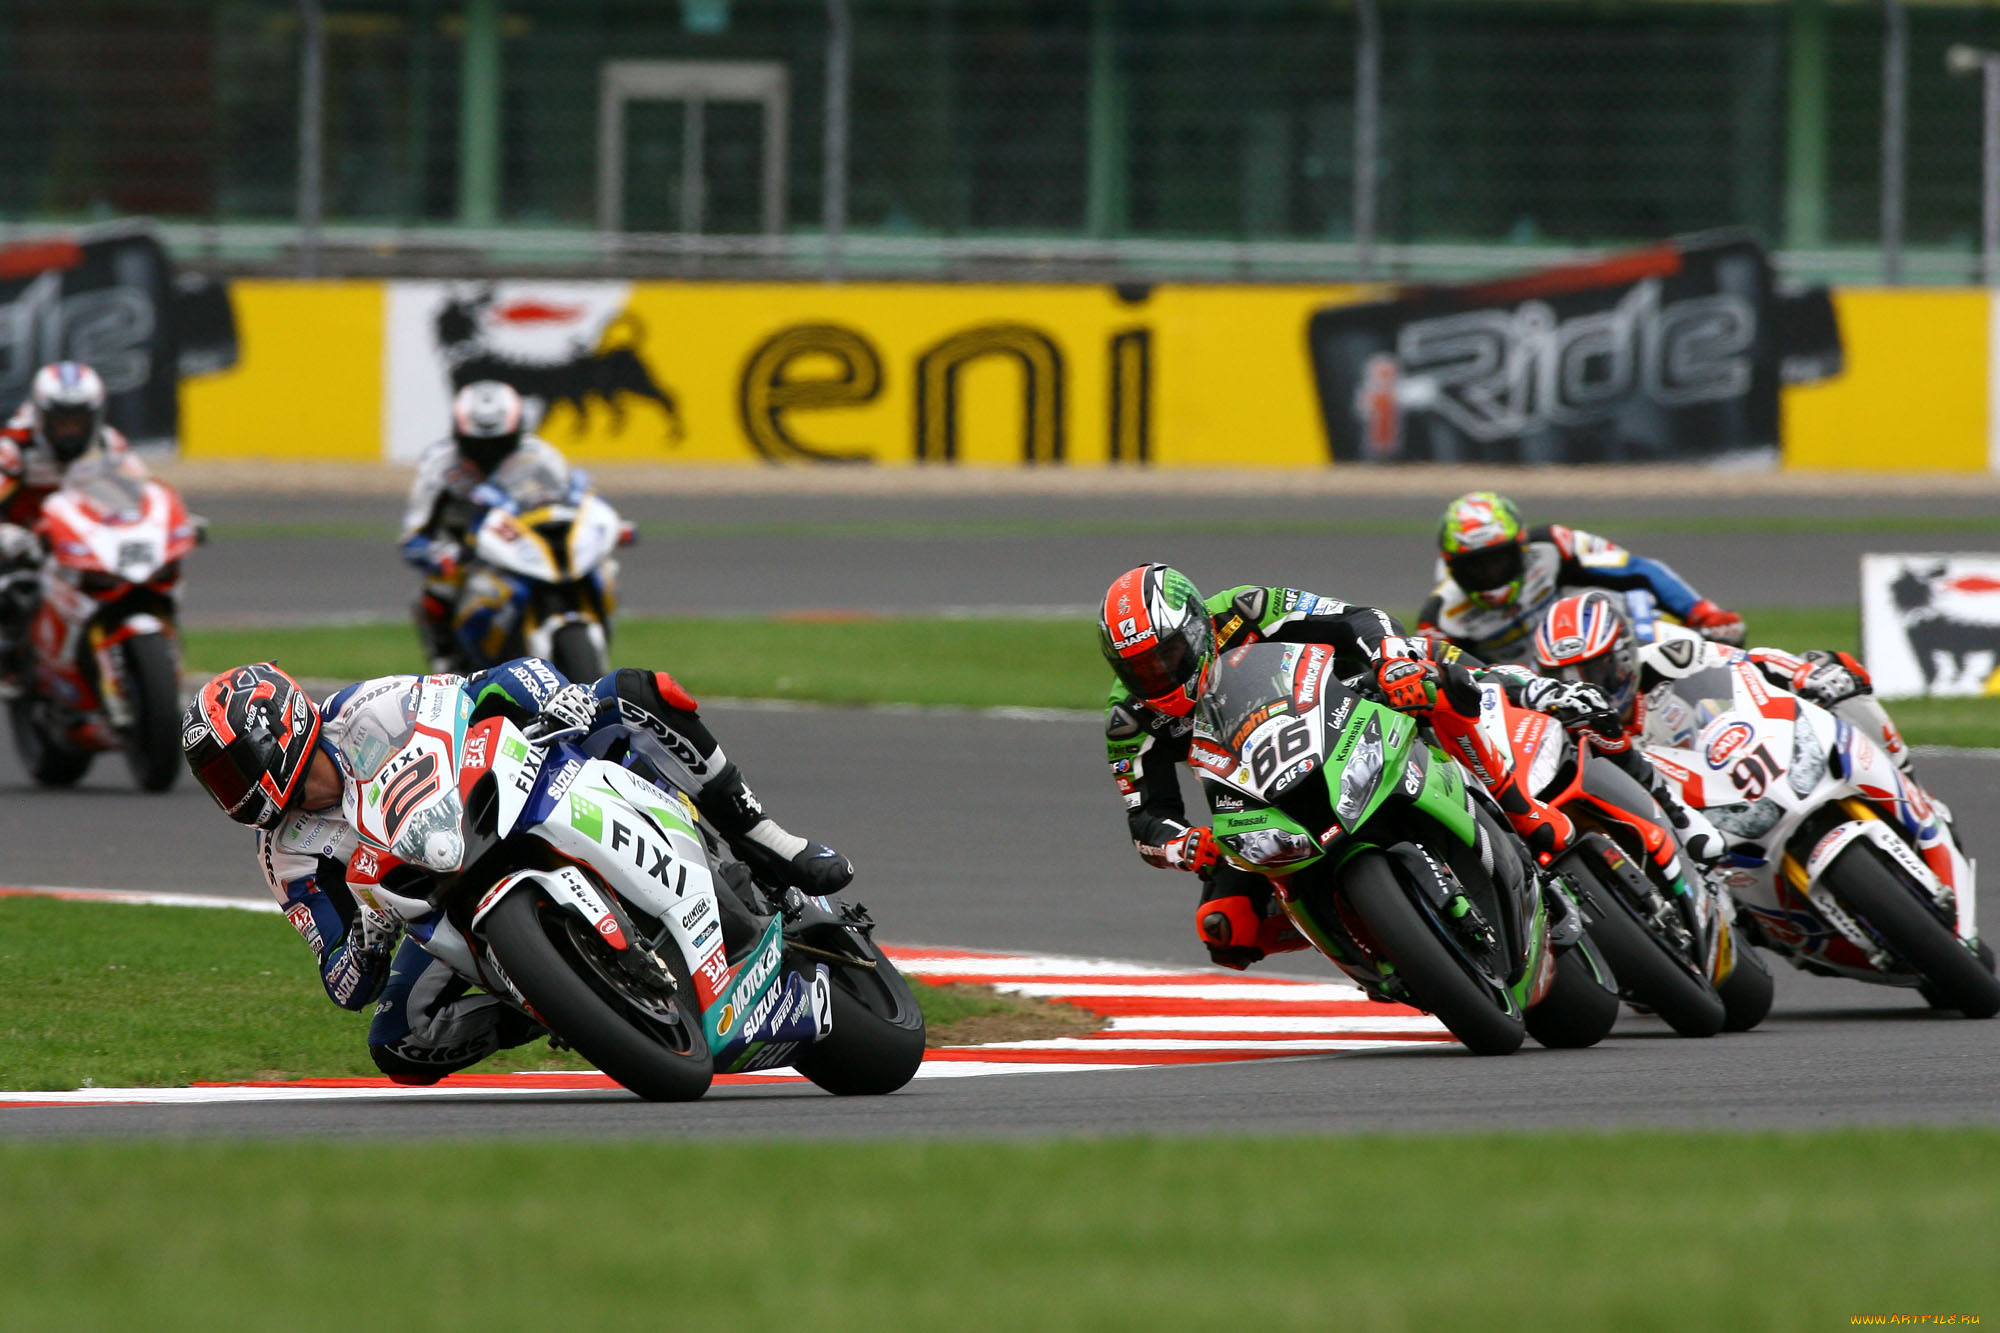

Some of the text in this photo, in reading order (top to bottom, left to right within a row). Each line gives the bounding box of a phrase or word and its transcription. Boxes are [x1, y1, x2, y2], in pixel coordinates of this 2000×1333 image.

[737, 281, 1154, 464] eni
[1113, 626, 1157, 650] SHARK
[620, 700, 708, 776] SPIDI
[1252, 718, 1311, 790] 66
[1336, 717, 1367, 762] Kawasaki
[380, 747, 423, 785] FIXI
[548, 758, 582, 800] SUZUKI
[1276, 767, 1299, 791] elf
[1728, 744, 1786, 802] 91
[611, 819, 688, 898] FIXI
[335, 965, 361, 1005] SUZU
[744, 976, 782, 1044] SUZUKI
[816, 979, 830, 1034] 2
[771, 988, 794, 1036] PIRELLI
